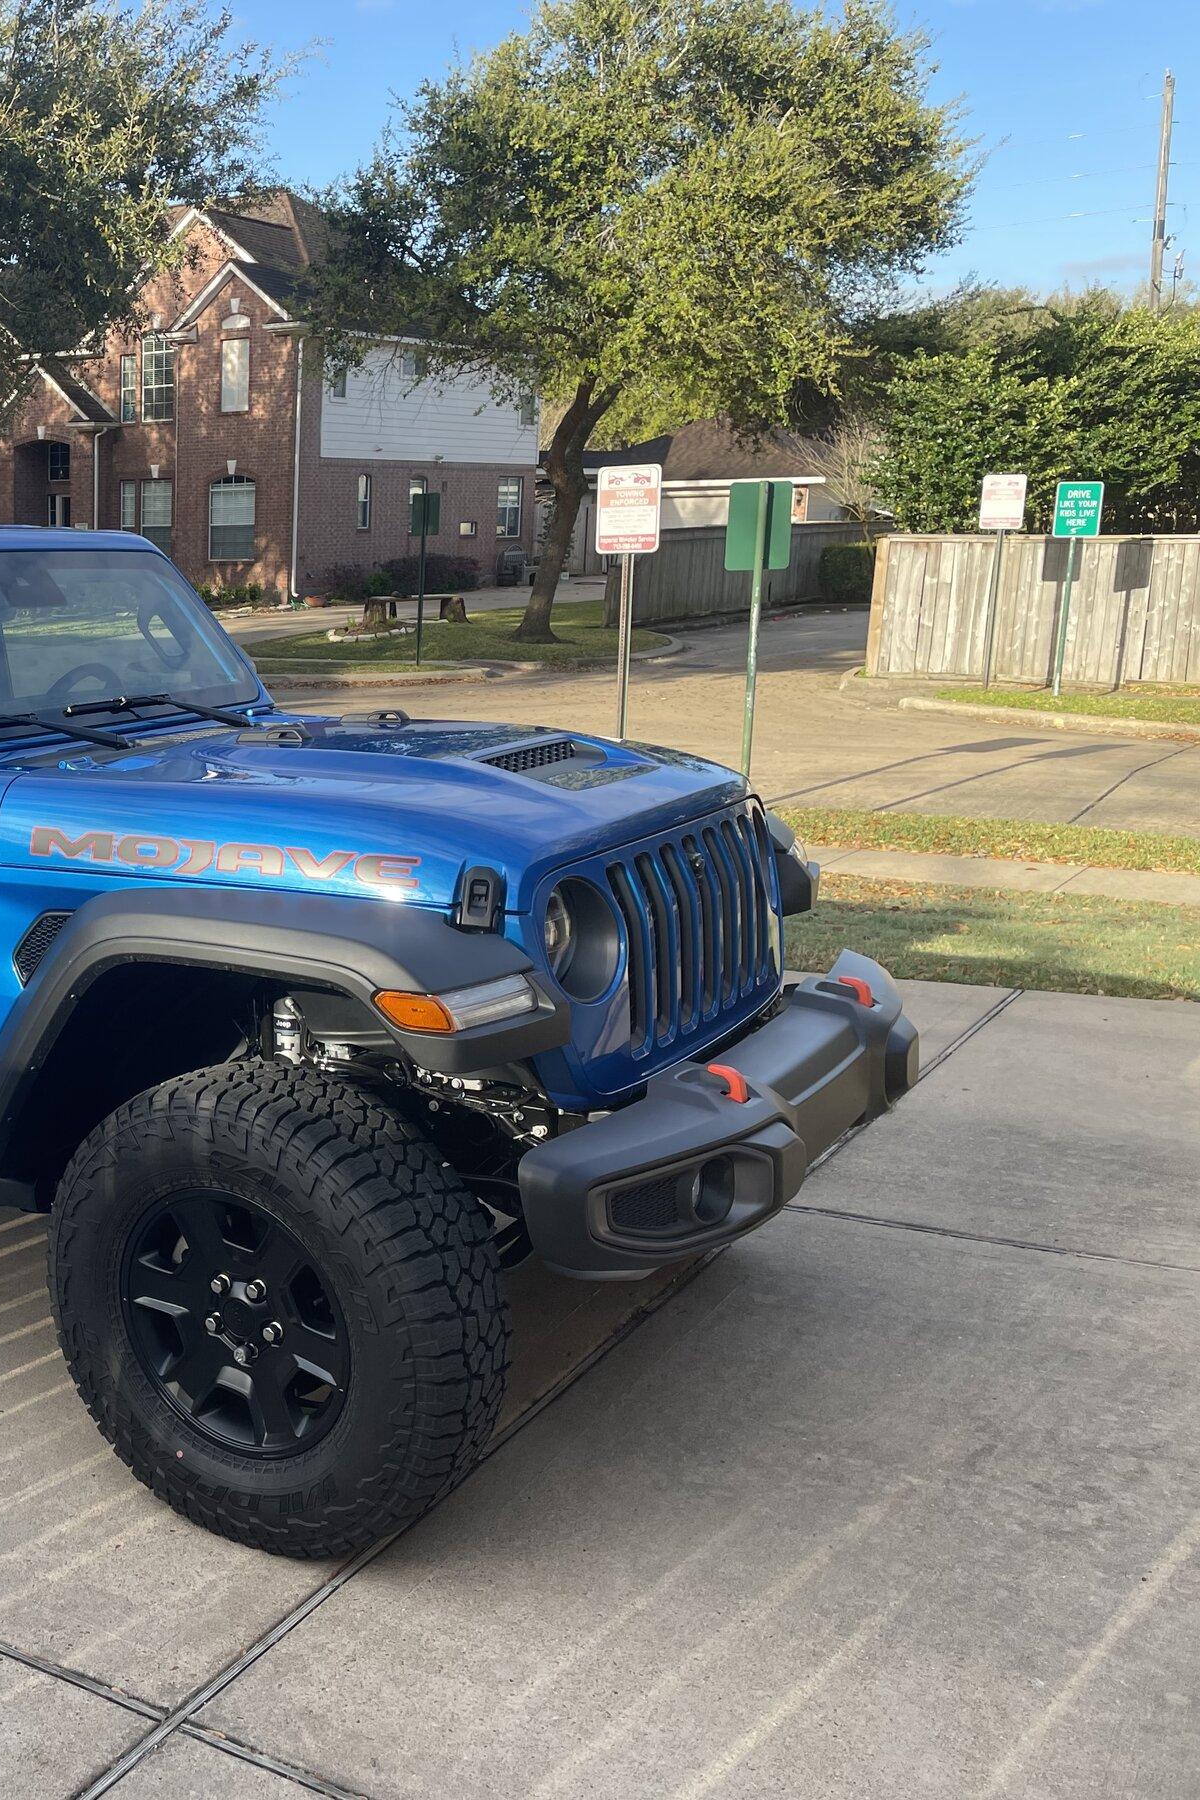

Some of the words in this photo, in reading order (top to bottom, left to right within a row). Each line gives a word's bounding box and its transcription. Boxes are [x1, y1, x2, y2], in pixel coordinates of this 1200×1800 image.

[616, 490, 645, 498] TOWING
[1067, 490, 1092, 499] DRIVE
[609, 498, 649, 506] ENFORCED
[1060, 500, 1075, 508] LIKE
[1079, 500, 1098, 508] YOUR
[1060, 509, 1077, 517] KIDS
[1079, 509, 1096, 517] LIVE
[1066, 518, 1087, 526] HERE
[29, 826, 421, 888] MOJAVE
